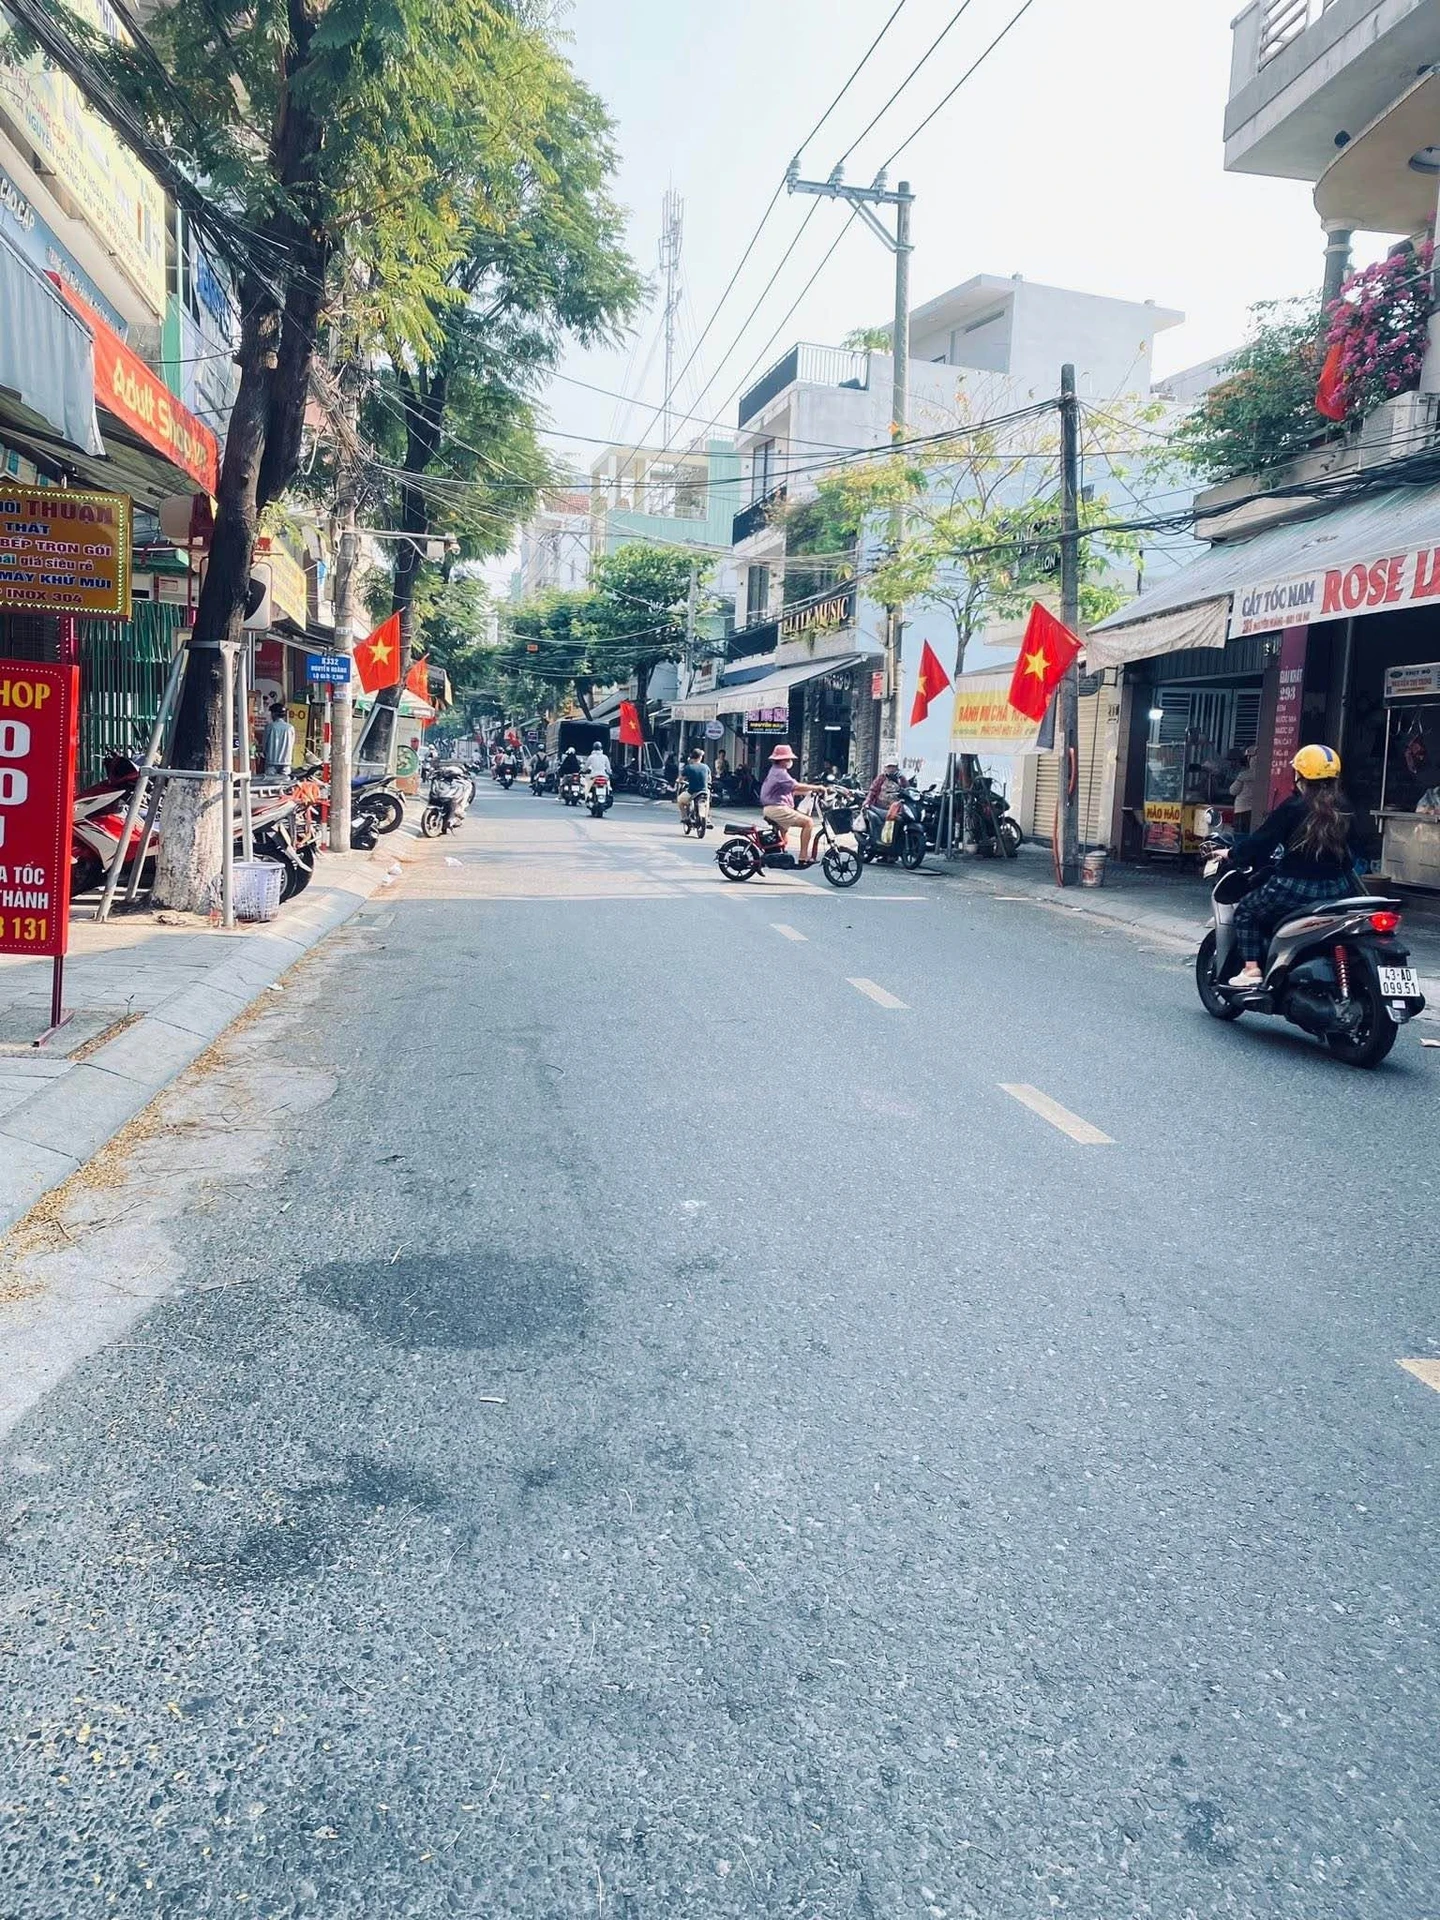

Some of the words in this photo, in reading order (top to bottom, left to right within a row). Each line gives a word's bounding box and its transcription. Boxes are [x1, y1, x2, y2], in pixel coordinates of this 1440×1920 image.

[112, 356, 158, 428] Adult
[26, 499, 114, 524] THUẬN
[0, 536, 32, 549] BẾP
[36, 540, 79, 555] TRỌN
[83, 543, 112, 557] GÓI
[20, 555, 42, 567] giá
[46, 557, 75, 569] siêu
[7, 588, 47, 601] INOX
[52, 592, 83, 603] 304
[1288, 580, 1315, 608] NAM
[1320, 554, 1407, 615] ROSE
[814, 596, 849, 628] MUSIC
[1279, 686, 1296, 700] 293
[13, 861, 45, 885] TỐC
[0, 887, 49, 909] HÀNH
[12, 917, 47, 940] 131
[1385, 968, 1411, 982] 43-AD
